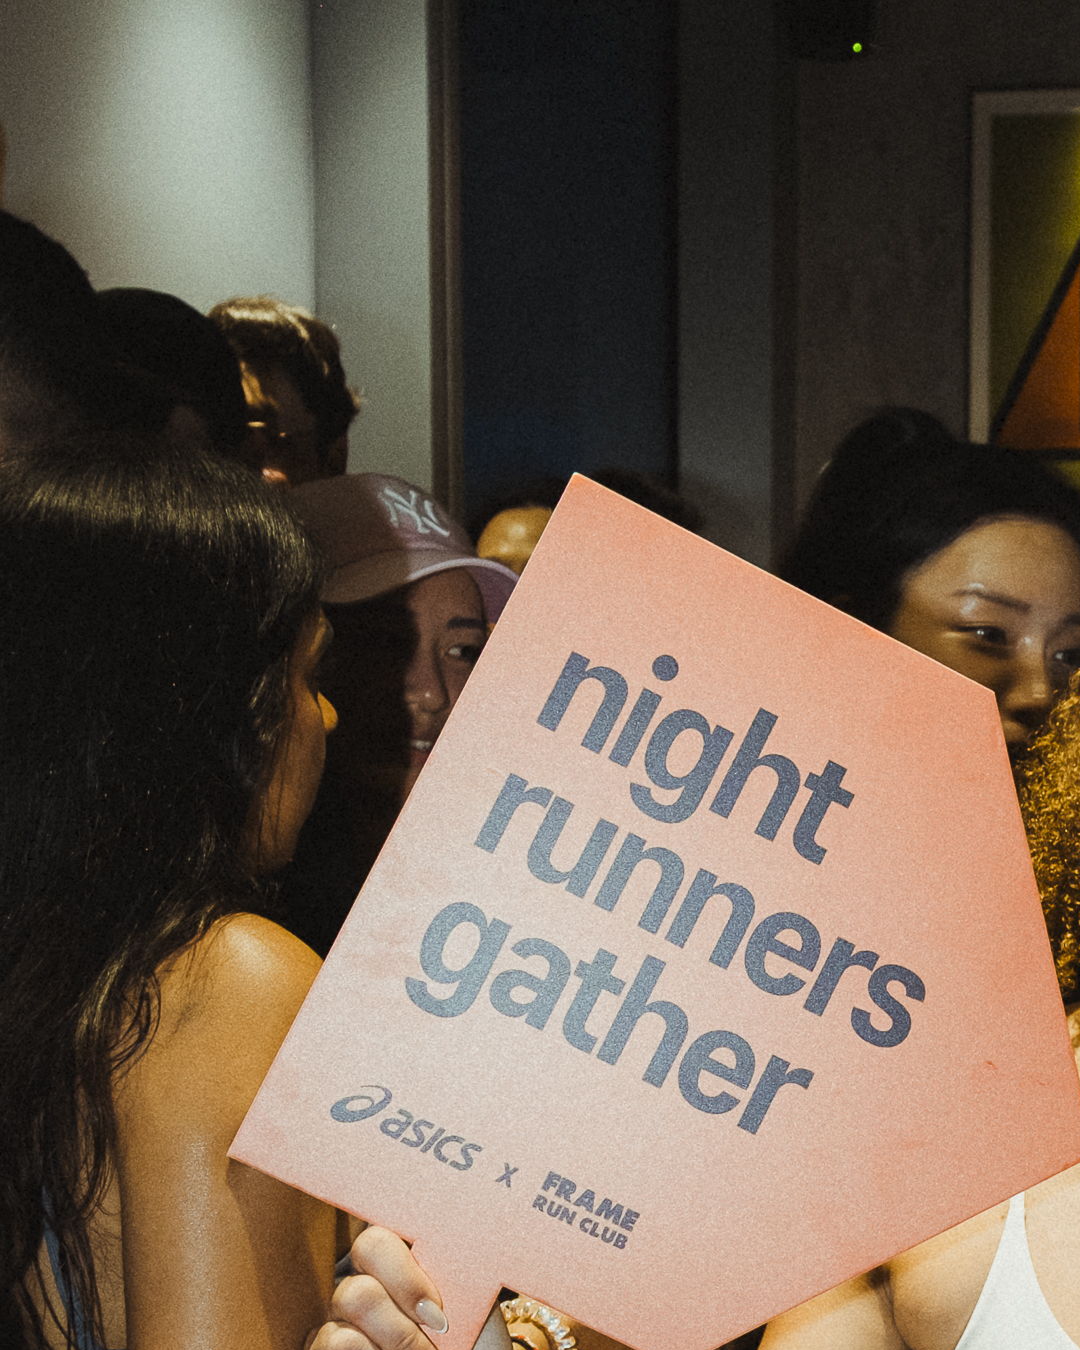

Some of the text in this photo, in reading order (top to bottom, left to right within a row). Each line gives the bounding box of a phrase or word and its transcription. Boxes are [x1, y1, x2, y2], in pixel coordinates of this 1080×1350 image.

[536, 651, 855, 866] night
[474, 772, 926, 1048] runners
[405, 902, 814, 1135] gather
[379, 1108, 483, 1171] asics
[541, 1171, 640, 1232] FRAME
[532, 1194, 629, 1250] RUN CLUB
